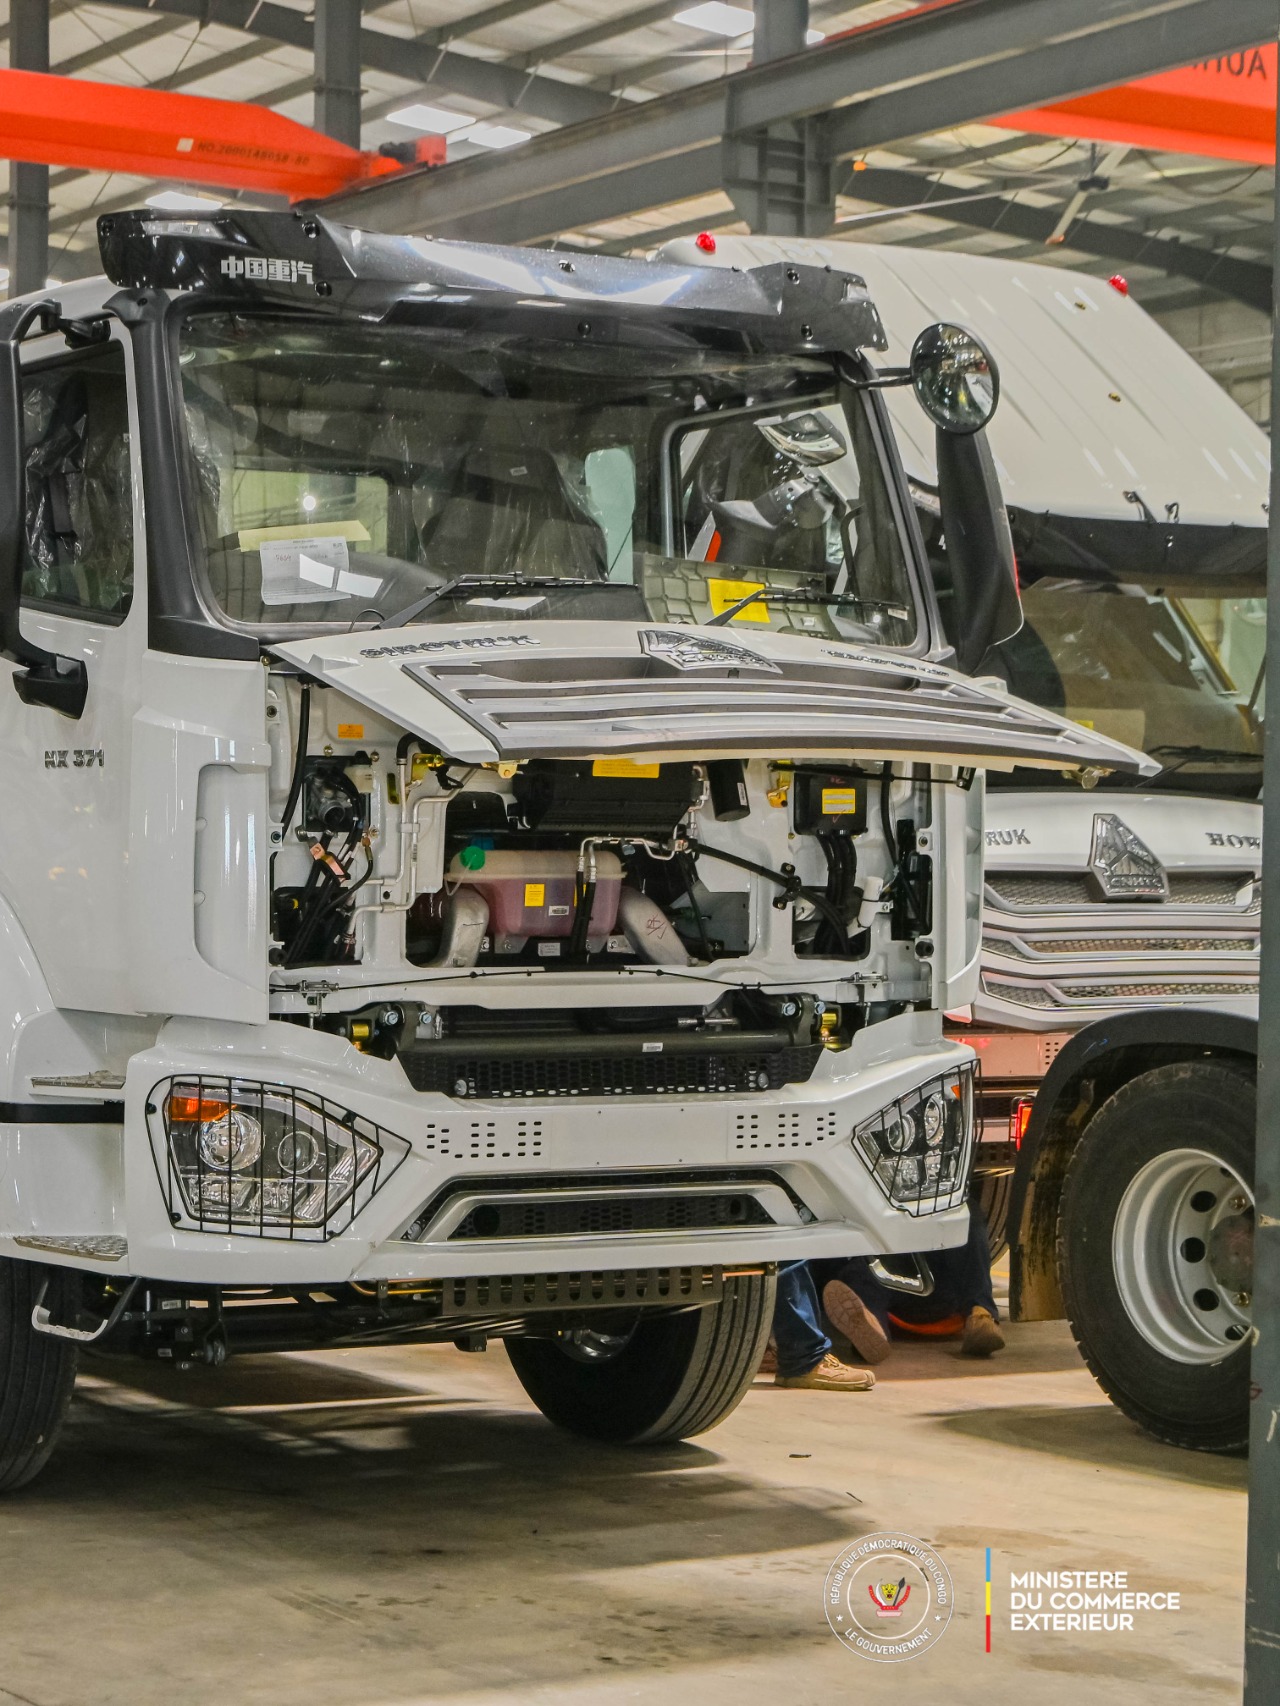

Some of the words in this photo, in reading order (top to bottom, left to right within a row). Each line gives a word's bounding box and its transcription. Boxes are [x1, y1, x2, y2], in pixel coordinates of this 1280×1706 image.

[221, 255, 314, 285] 中国重汽
[73, 749, 104, 767] 371
